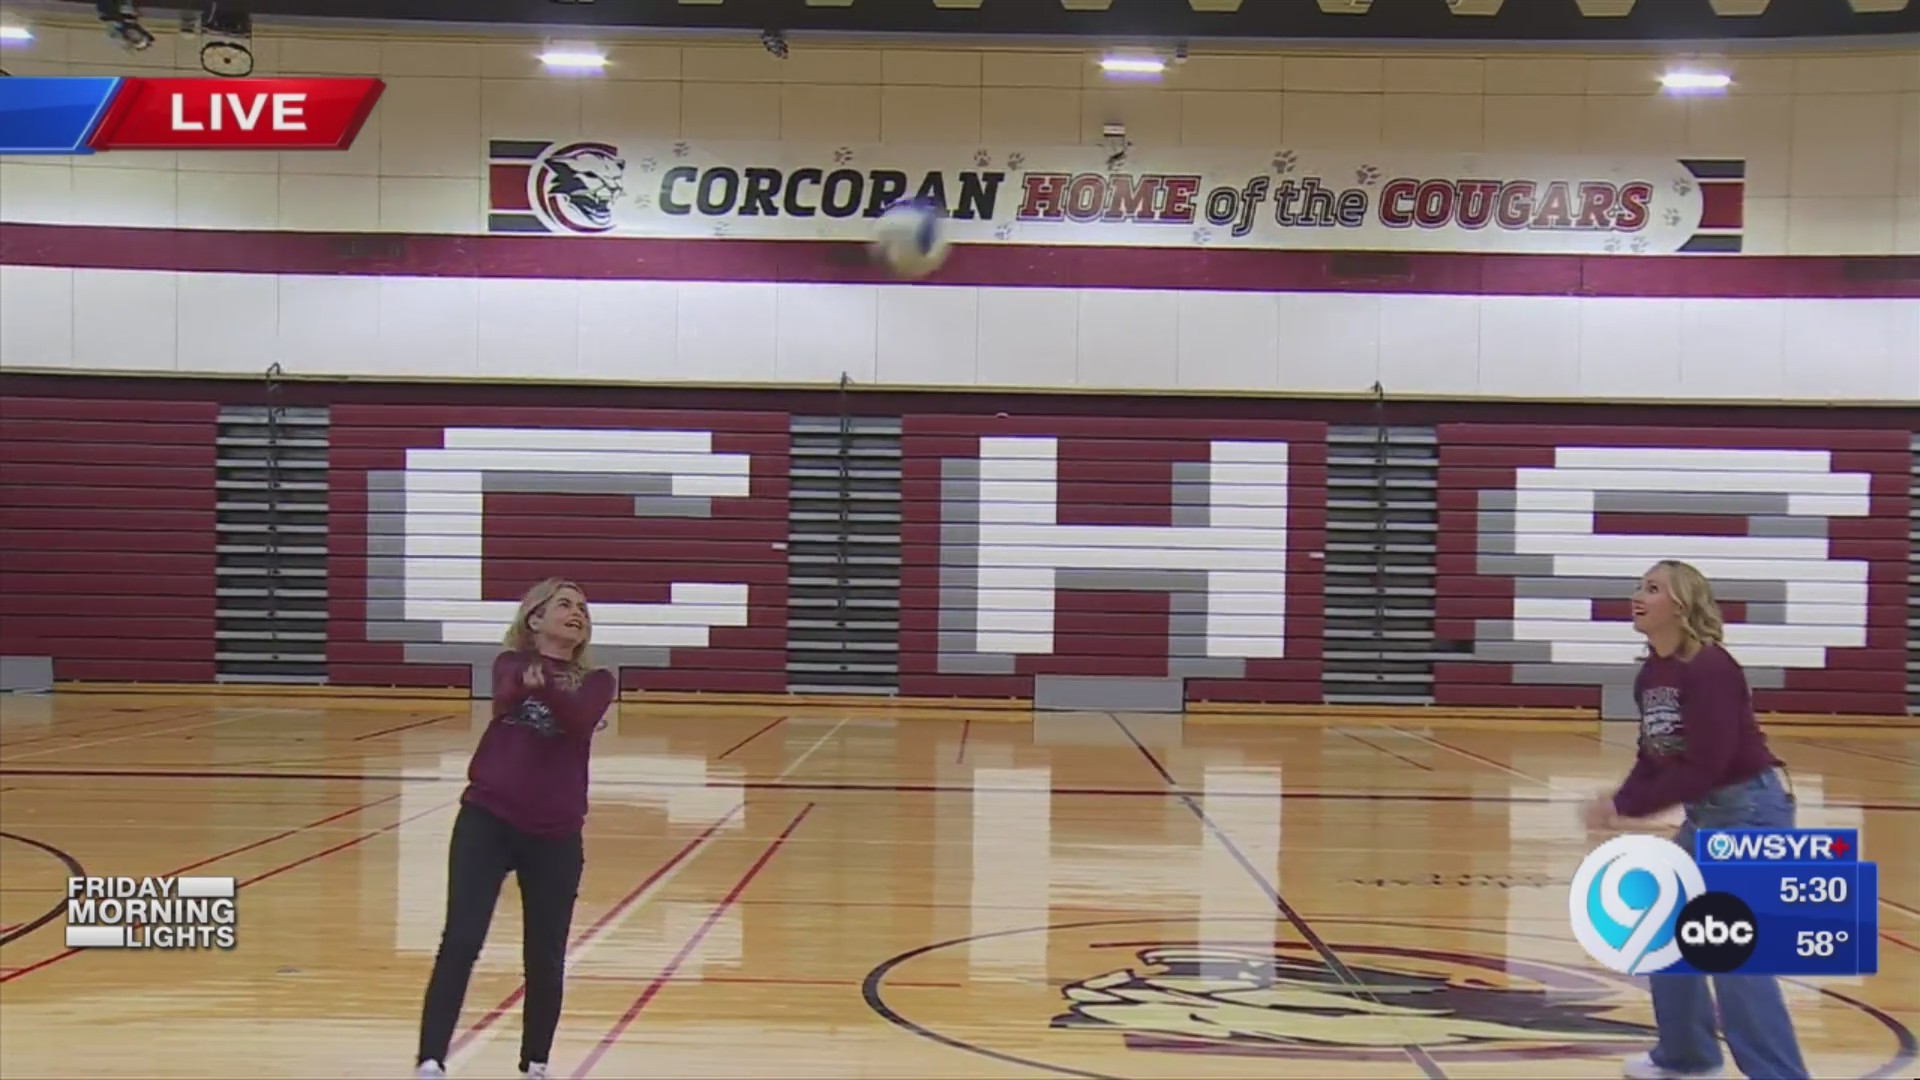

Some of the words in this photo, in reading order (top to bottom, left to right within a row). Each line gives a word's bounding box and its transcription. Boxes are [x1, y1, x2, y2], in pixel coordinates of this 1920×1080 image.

[659, 167, 1006, 220] CORCORAN
[1016, 173, 1201, 224] HOME
[1205, 177, 1271, 237] of
[1274, 178, 1369, 230] the
[1379, 179, 1654, 232] COUGARS
